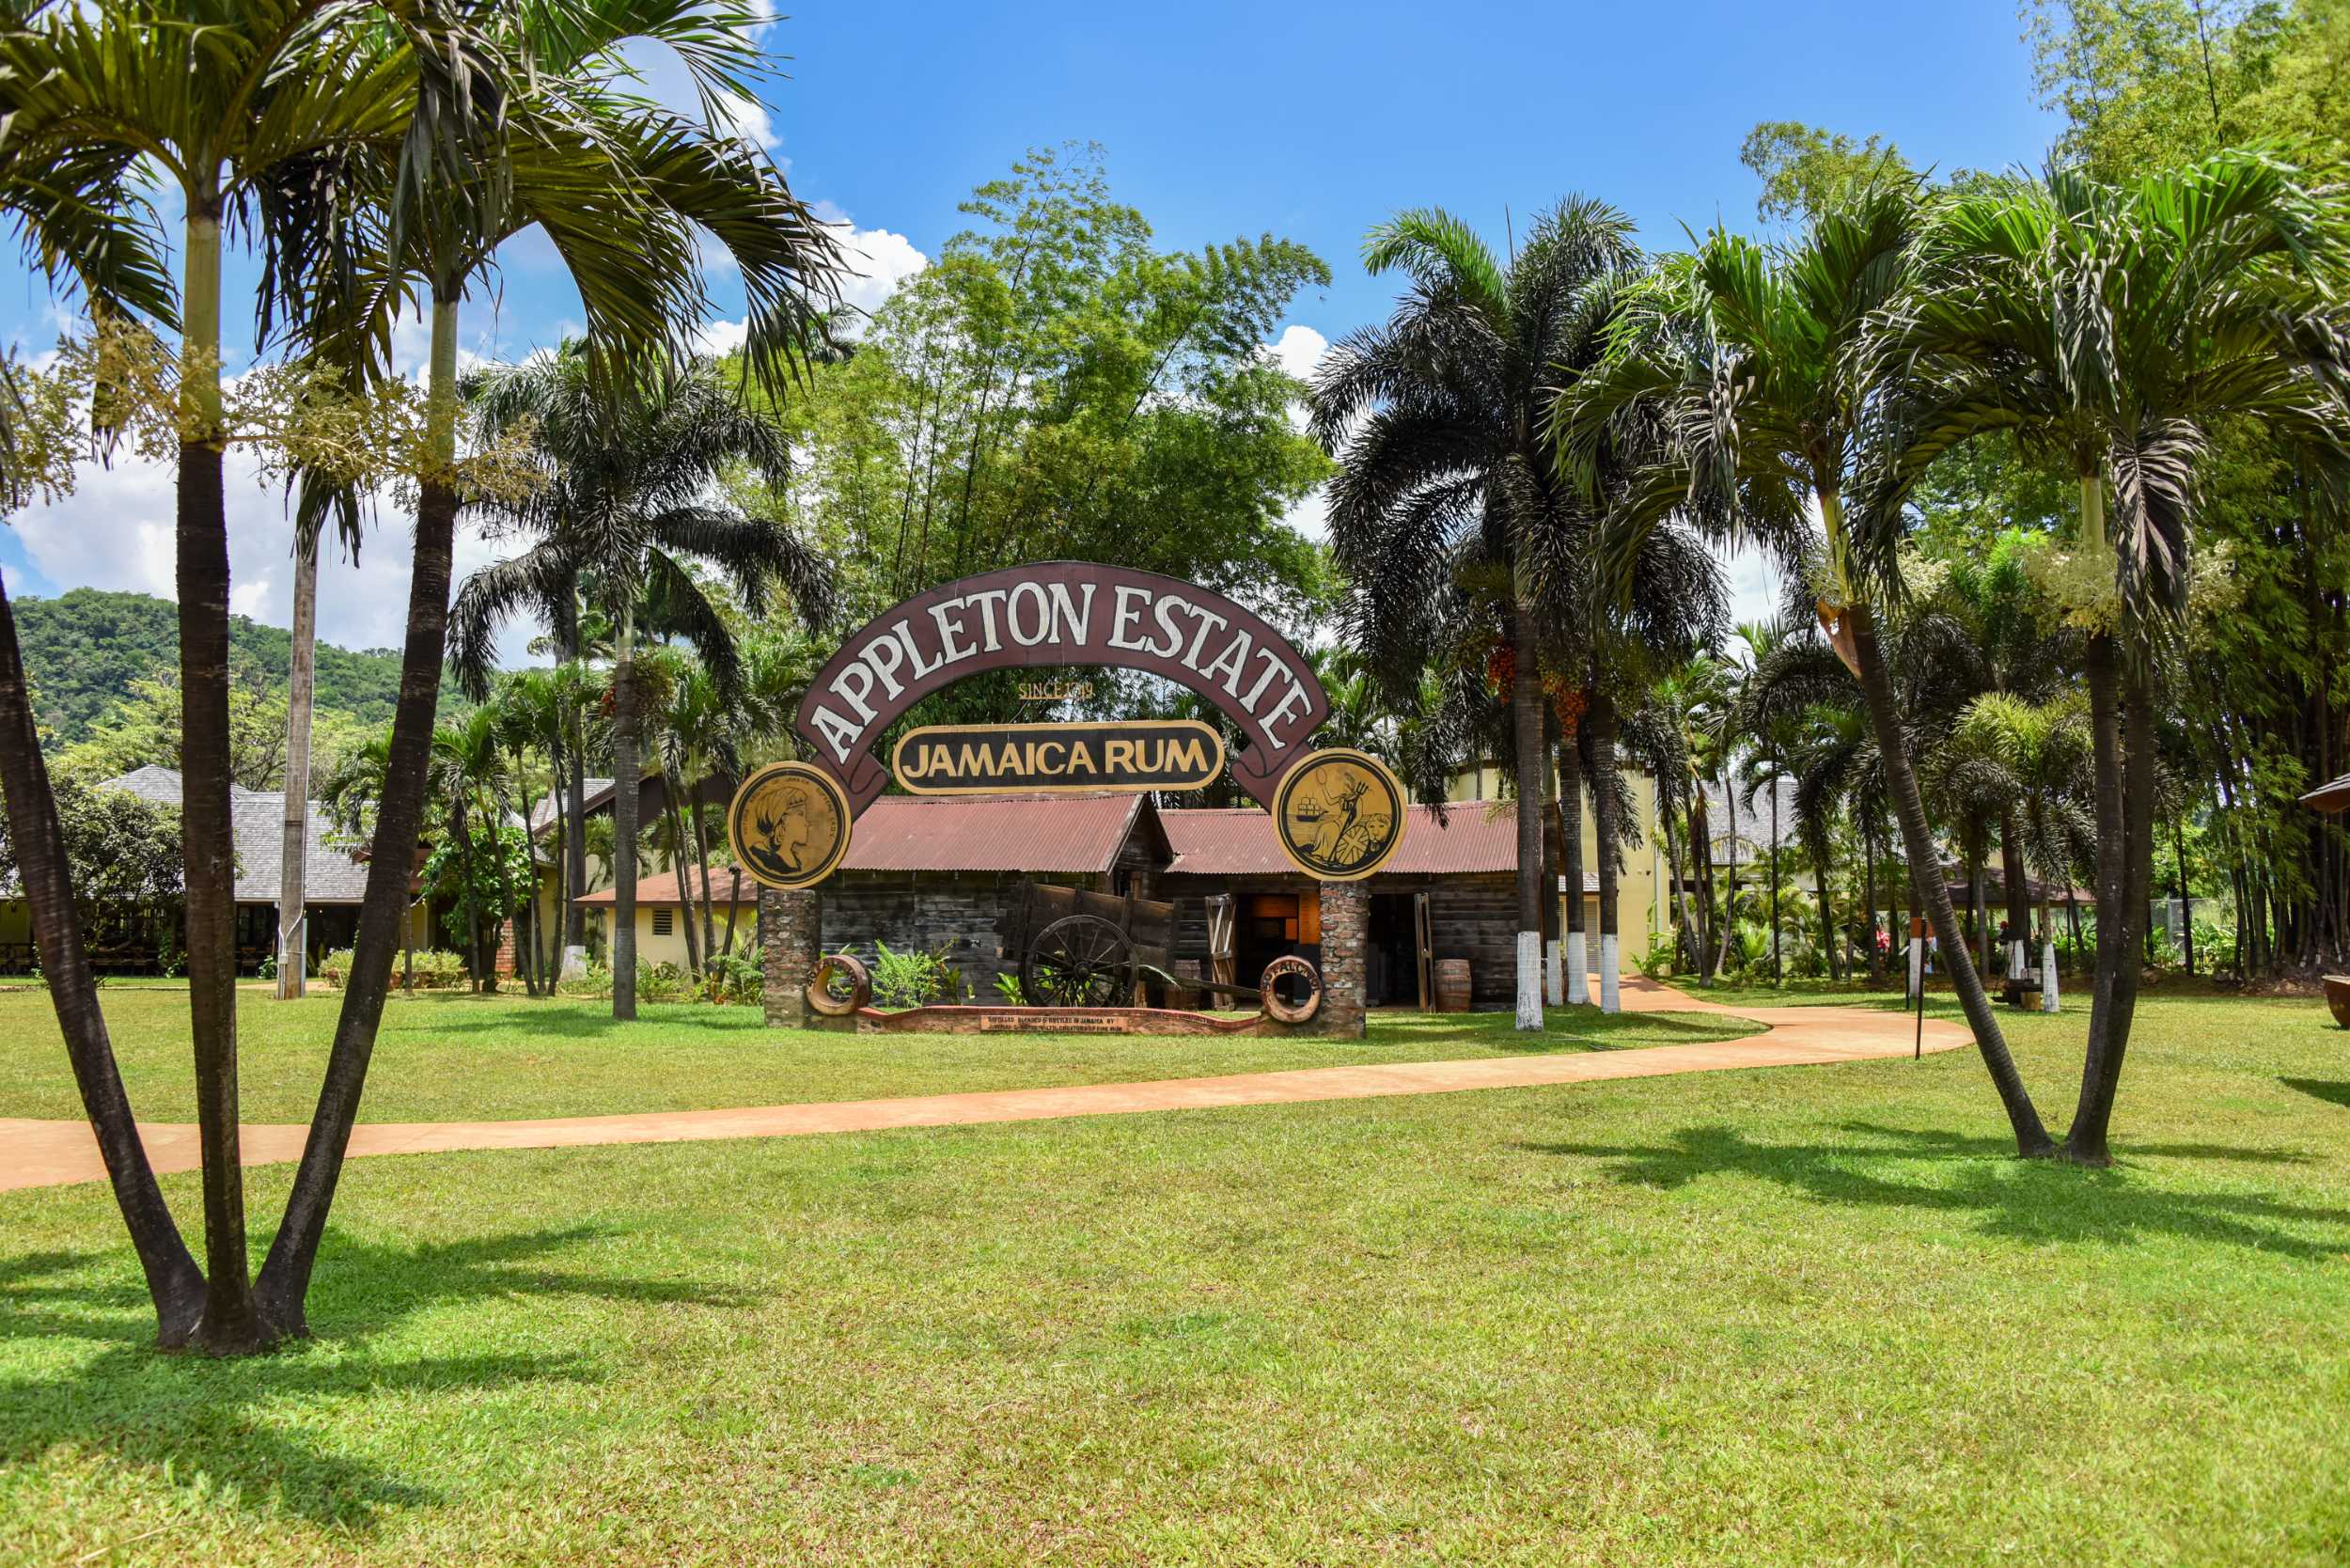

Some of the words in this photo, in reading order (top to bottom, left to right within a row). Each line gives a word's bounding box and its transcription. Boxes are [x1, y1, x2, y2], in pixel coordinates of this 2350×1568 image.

[810, 581, 1097, 765] APPLETON
[1107, 584, 1312, 749] ESTATE
[1018, 682, 1063, 698] SINCE
[902, 740, 1097, 777] JAMAICA
[1105, 738, 1209, 774] RUM
